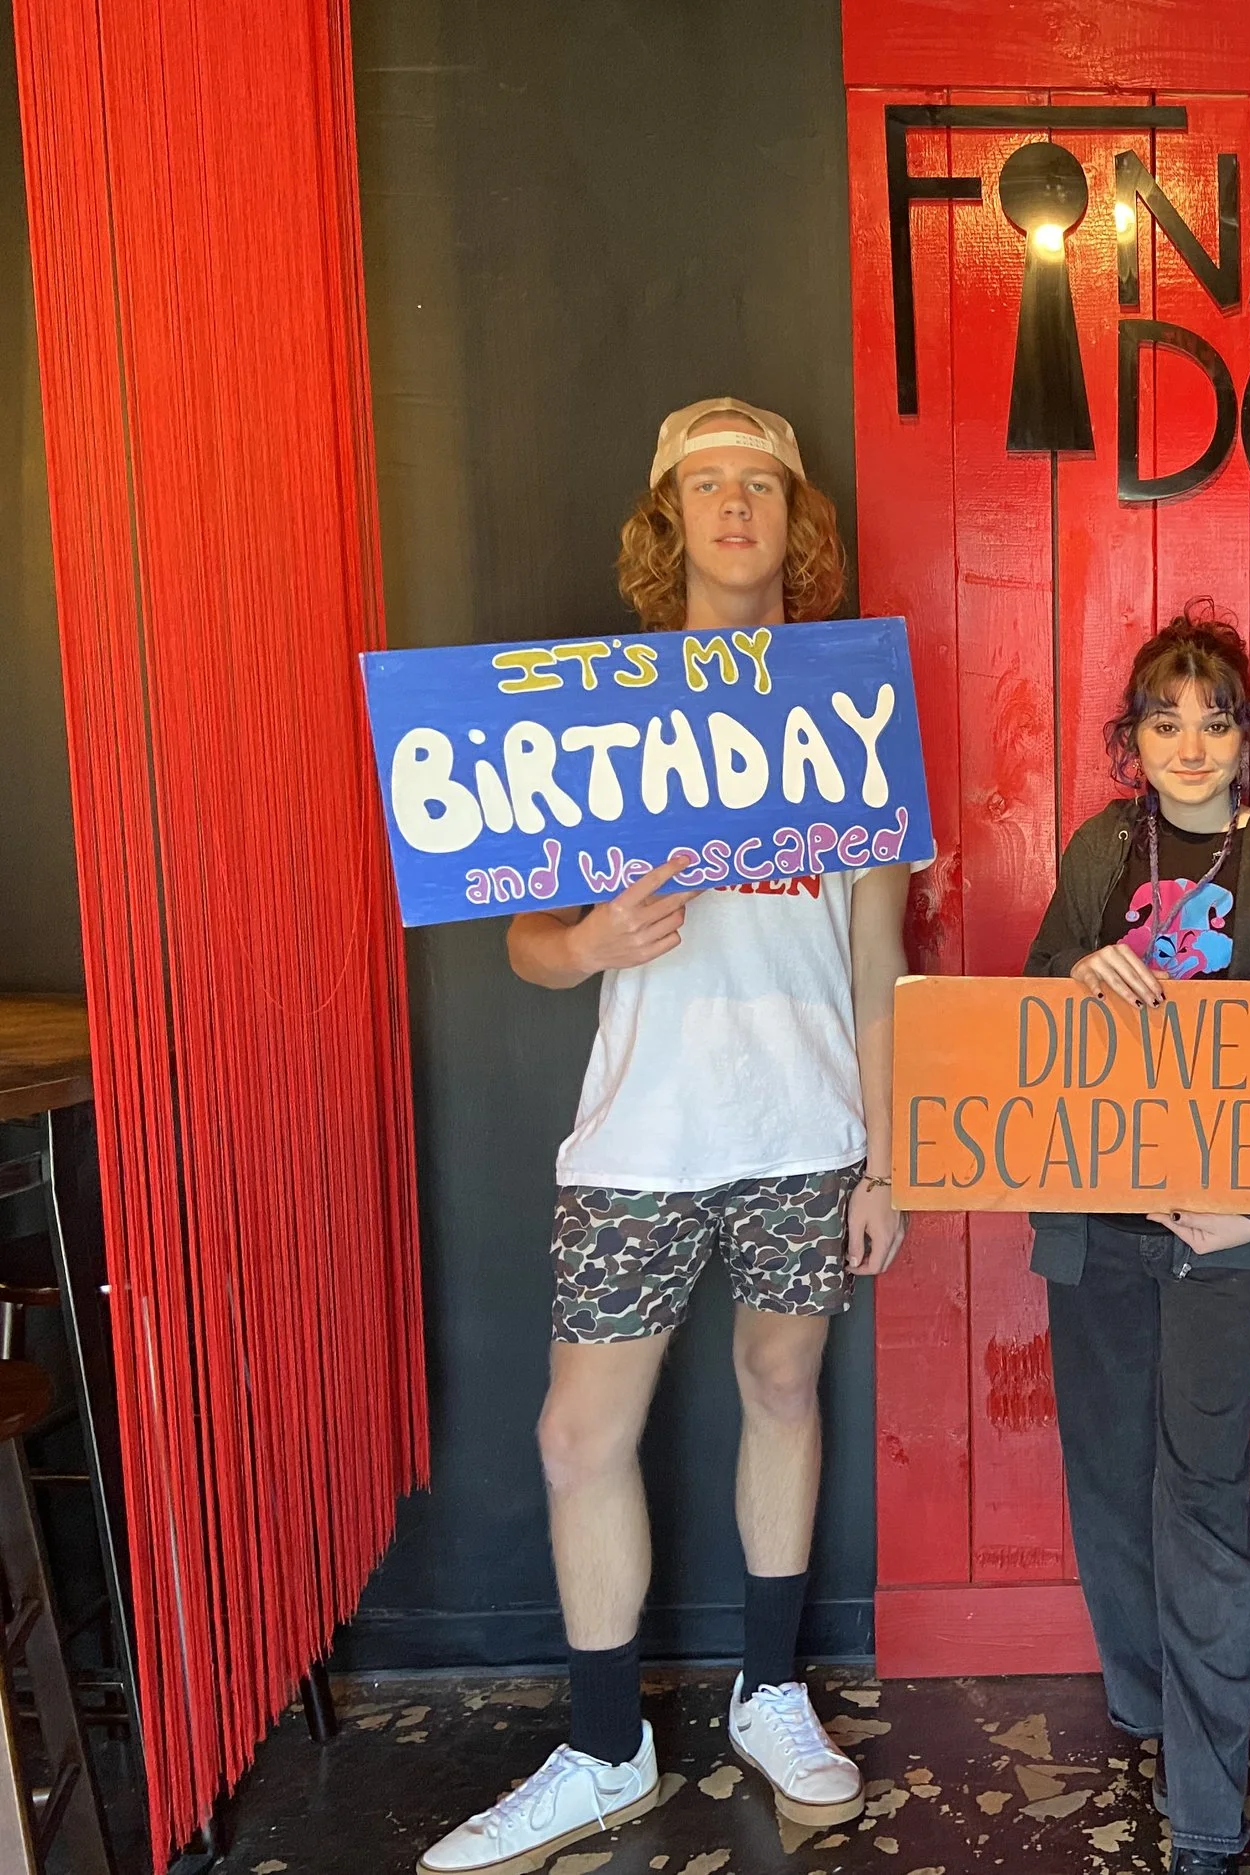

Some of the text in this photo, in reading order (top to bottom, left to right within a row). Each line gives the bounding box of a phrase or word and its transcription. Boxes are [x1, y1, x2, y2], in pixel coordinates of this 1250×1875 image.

[492, 627, 772, 695] IT'S MY
[466, 839, 561, 904] and
[667, 806, 909, 886] escaped
[1019, 996, 1249, 1090] DID WE
[909, 1096, 1168, 1190] ESCAPE
